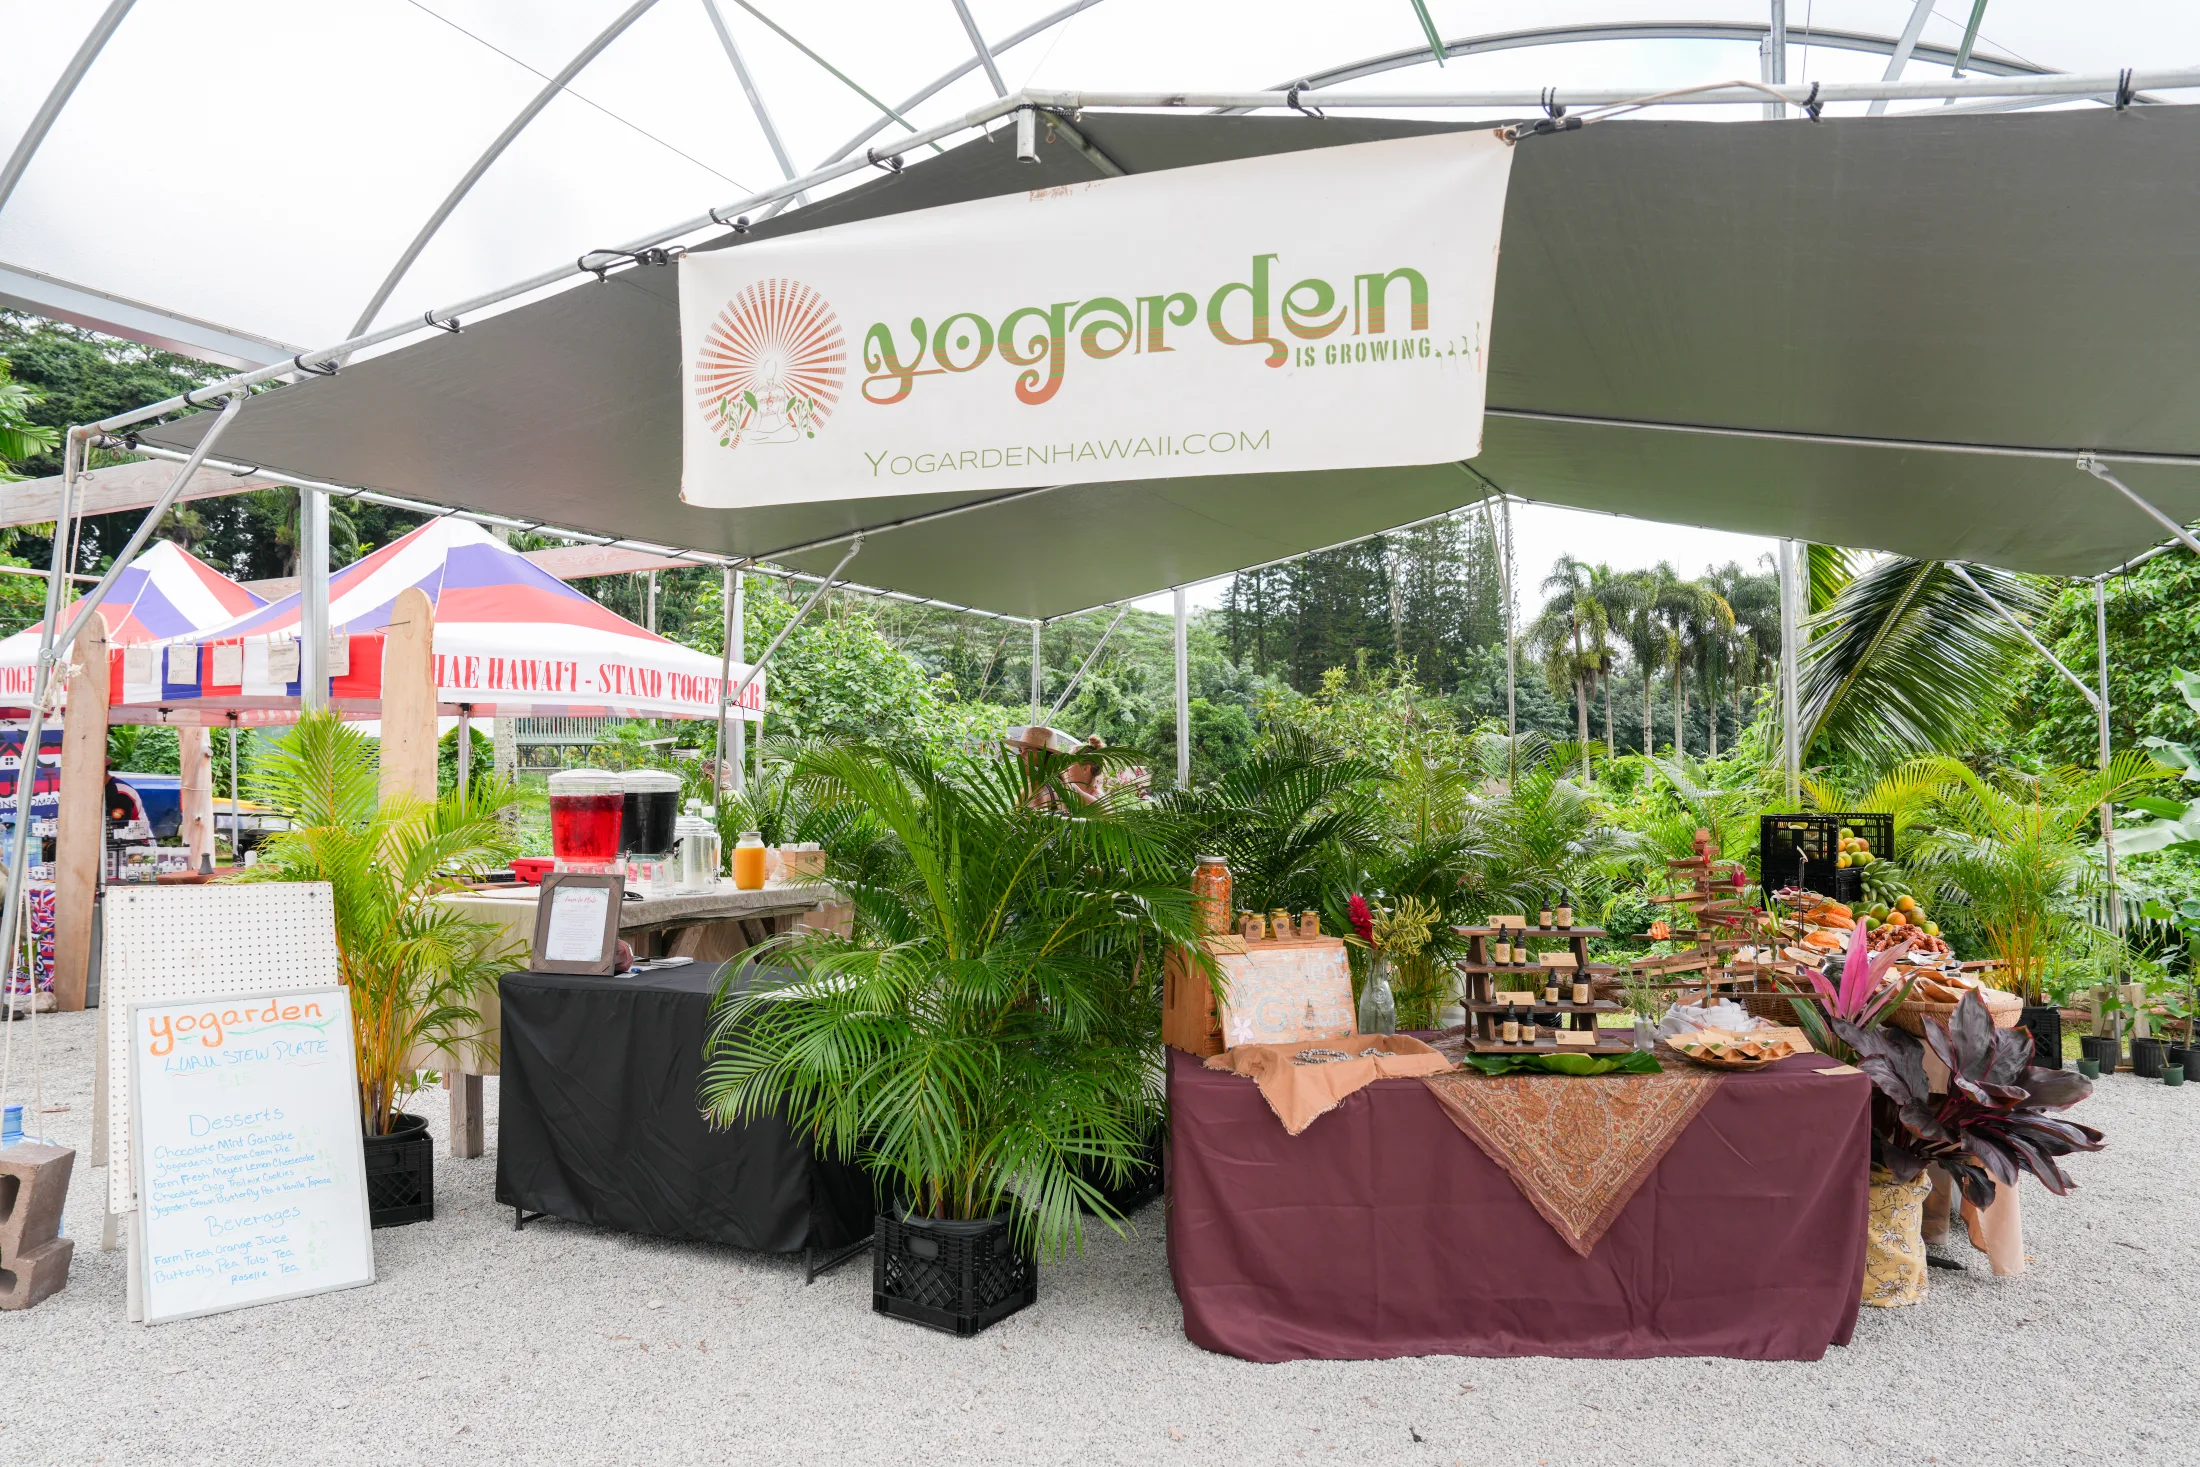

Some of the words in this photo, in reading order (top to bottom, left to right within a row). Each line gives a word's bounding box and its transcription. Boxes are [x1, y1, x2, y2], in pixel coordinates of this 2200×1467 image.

[861, 253, 1430, 406] yogarden
[1296, 346, 1316, 368] IS
[598, 662, 662, 699] STAND
[149, 999, 323, 1057] yogarden
[222, 1049, 270, 1065] STEW
[272, 1039, 329, 1061] PLATE
[189, 1107, 285, 1137] Desserts
[153, 1145, 215, 1160] Chocolate
[217, 1139, 245, 1152] Mint
[247, 1131, 296, 1147] Ganache
[215, 1152, 249, 1164] Banana
[248, 1148, 274, 1160] Cream
[274, 1143, 292, 1155] Pie
[153, 1179, 180, 1191] Farm
[180, 1172, 211, 1186] Fresh
[212, 1164, 244, 1181] Meyer
[245, 1161, 273, 1173] Lemon
[271, 1153, 316, 1169] Cheesecake
[153, 1189, 200, 1202] Chocolate
[201, 1182, 226, 1195] Chip
[262, 1169, 295, 1182] Cookies
[189, 1196, 216, 1209] Grown
[215, 1188, 260, 1204] Butterfly
[260, 1184, 276, 1196] Pea
[282, 1180, 306, 1192] Vanilla
[305, 1174, 333, 1189] Tapioca
[204, 1206, 302, 1237] Beverages
[154, 1253, 184, 1267] Farm
[184, 1247, 214, 1262] Fresh
[254, 1232, 290, 1247] Juice
[154, 1264, 215, 1285] Butterfly
[215, 1256, 241, 1273] Pea
[243, 1252, 270, 1266] Tulsi
[272, 1248, 295, 1261] Tea
[231, 1270, 269, 1286] Roselle
[279, 1262, 300, 1274] Tea
